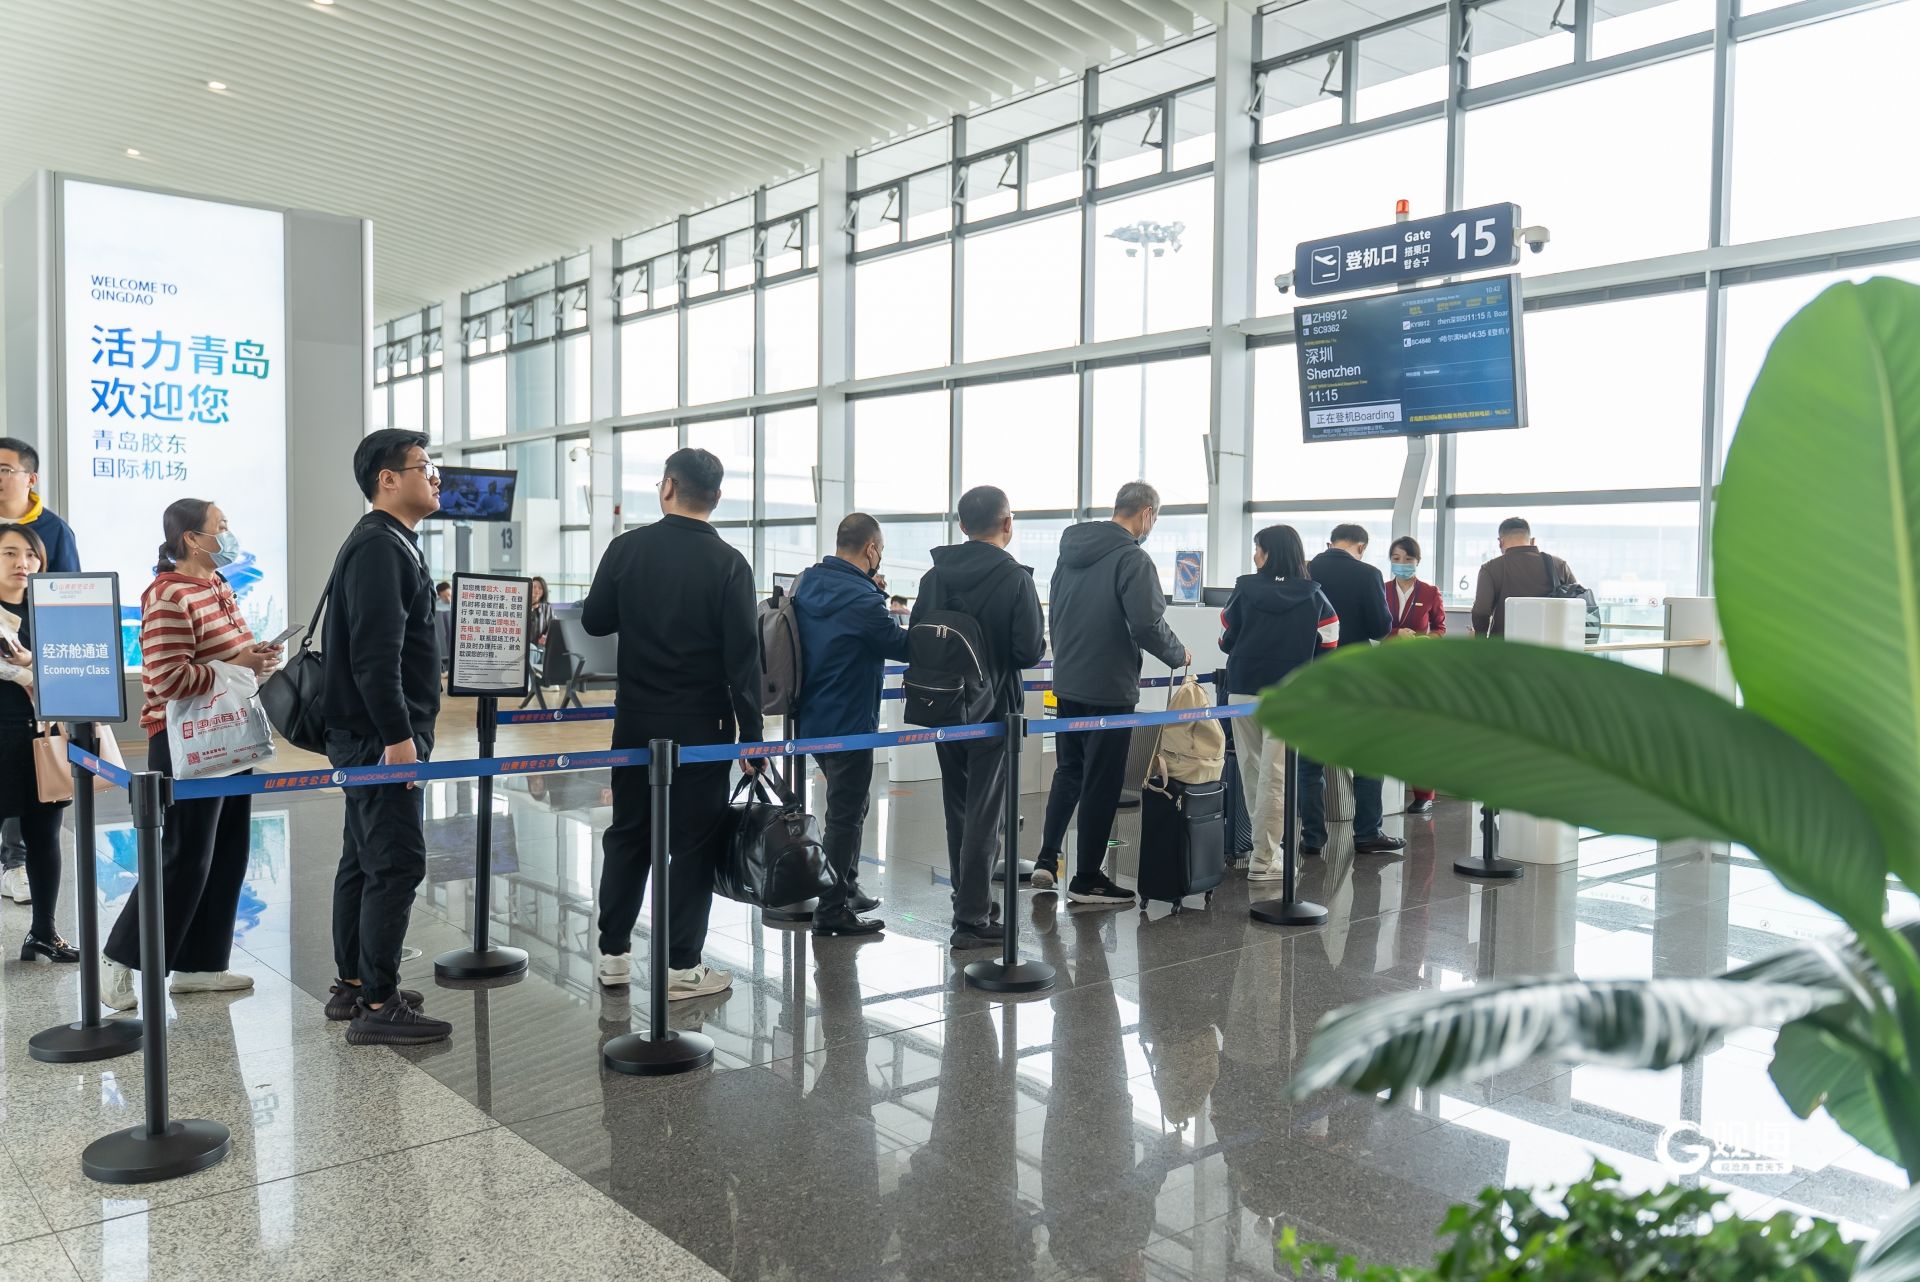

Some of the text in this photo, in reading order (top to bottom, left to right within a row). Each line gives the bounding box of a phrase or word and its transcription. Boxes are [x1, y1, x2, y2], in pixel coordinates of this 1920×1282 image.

[1404, 231, 1431, 242] Gate
[1450, 217, 1496, 260] 15
[1345, 244, 1398, 272] 登机口
[1403, 256, 1430, 270] 탑승구
[91, 274, 178, 295] WELCOME TO
[91, 288, 154, 305] QINGDAO
[1312, 309, 1348, 324] ZH9912
[1312, 324, 1340, 335] SC9362
[91, 324, 270, 380] 活力青岛
[1305, 346, 1334, 365] 深圳
[1306, 365, 1361, 381] Shenzhen
[91, 376, 230, 424] 欢迎您
[1308, 388, 1339, 402] 11:15
[92, 429, 187, 454] 青岛胶东
[93, 457, 187, 481] 国际机场
[501, 527, 513, 549] 13
[1459, 575, 1469, 590] 6
[42, 643, 110, 659] 经济舱通道
[43, 665, 110, 677] Economy Class
